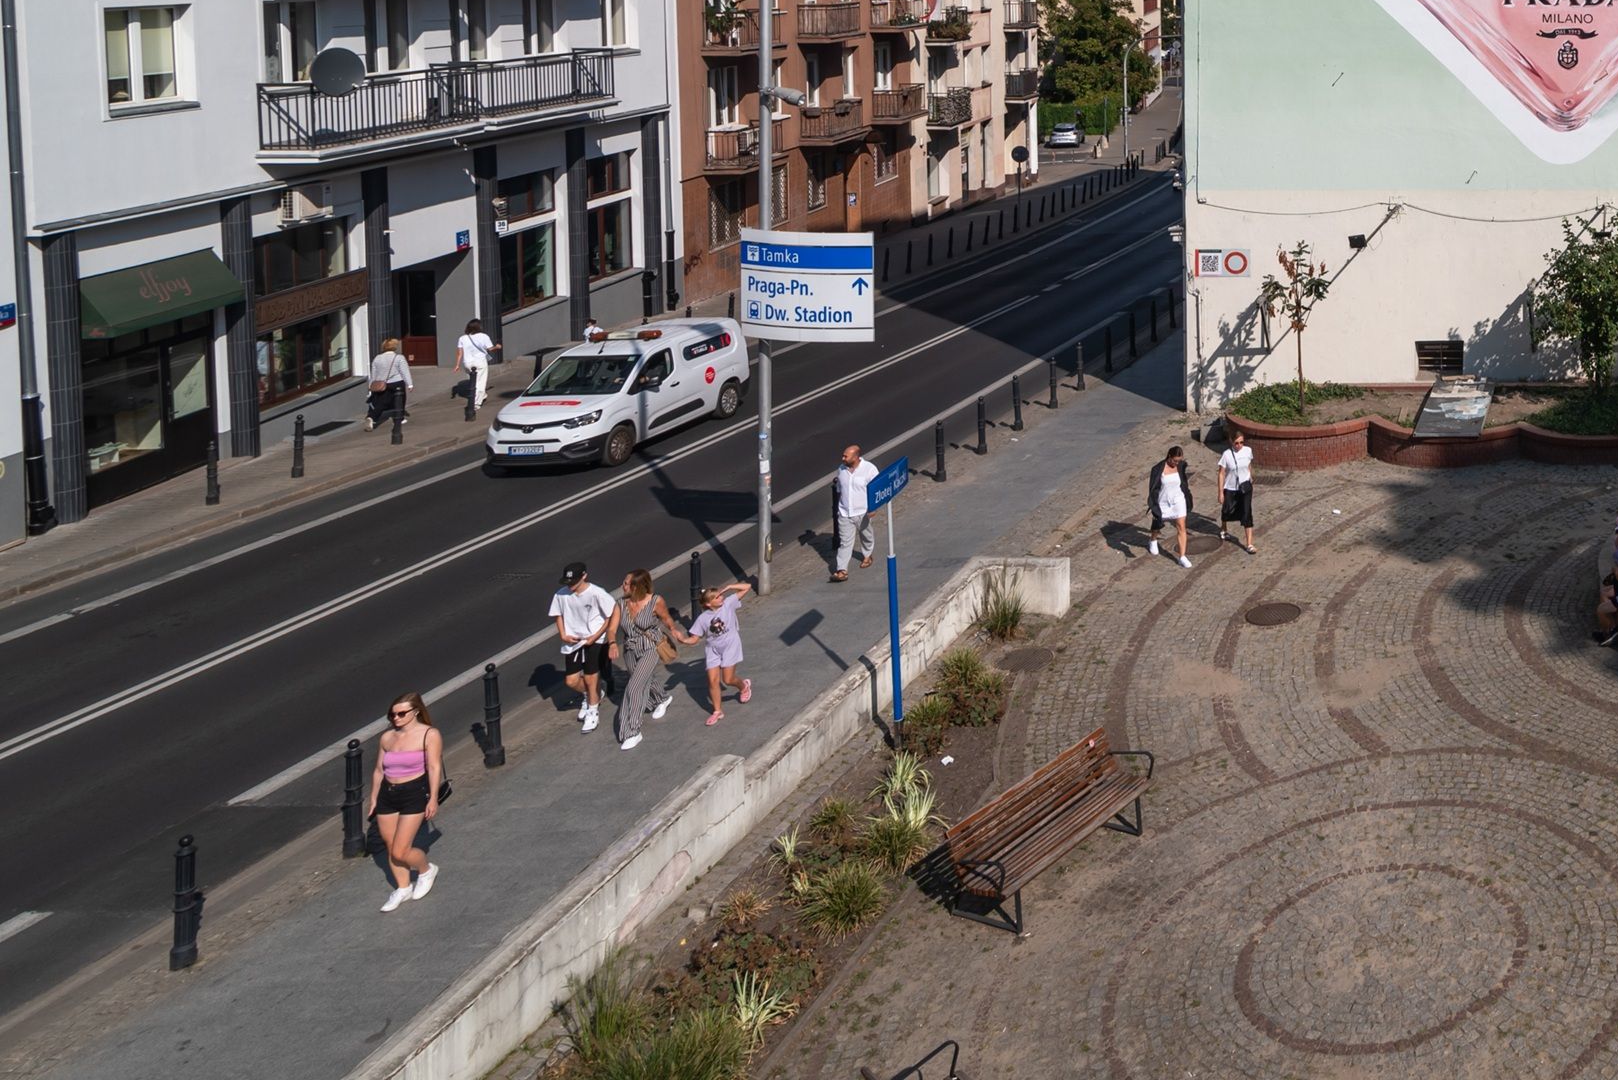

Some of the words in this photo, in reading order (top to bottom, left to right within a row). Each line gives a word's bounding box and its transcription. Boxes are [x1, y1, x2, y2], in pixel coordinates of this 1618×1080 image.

[1542, 13, 1593, 24] MILANO
[459, 234, 469, 245] 36
[762, 248, 799, 263] Tamka
[748, 276, 814, 298] Praga-Pn.
[765, 304, 789, 321] Dw.
[795, 306, 852, 323] Stadion
